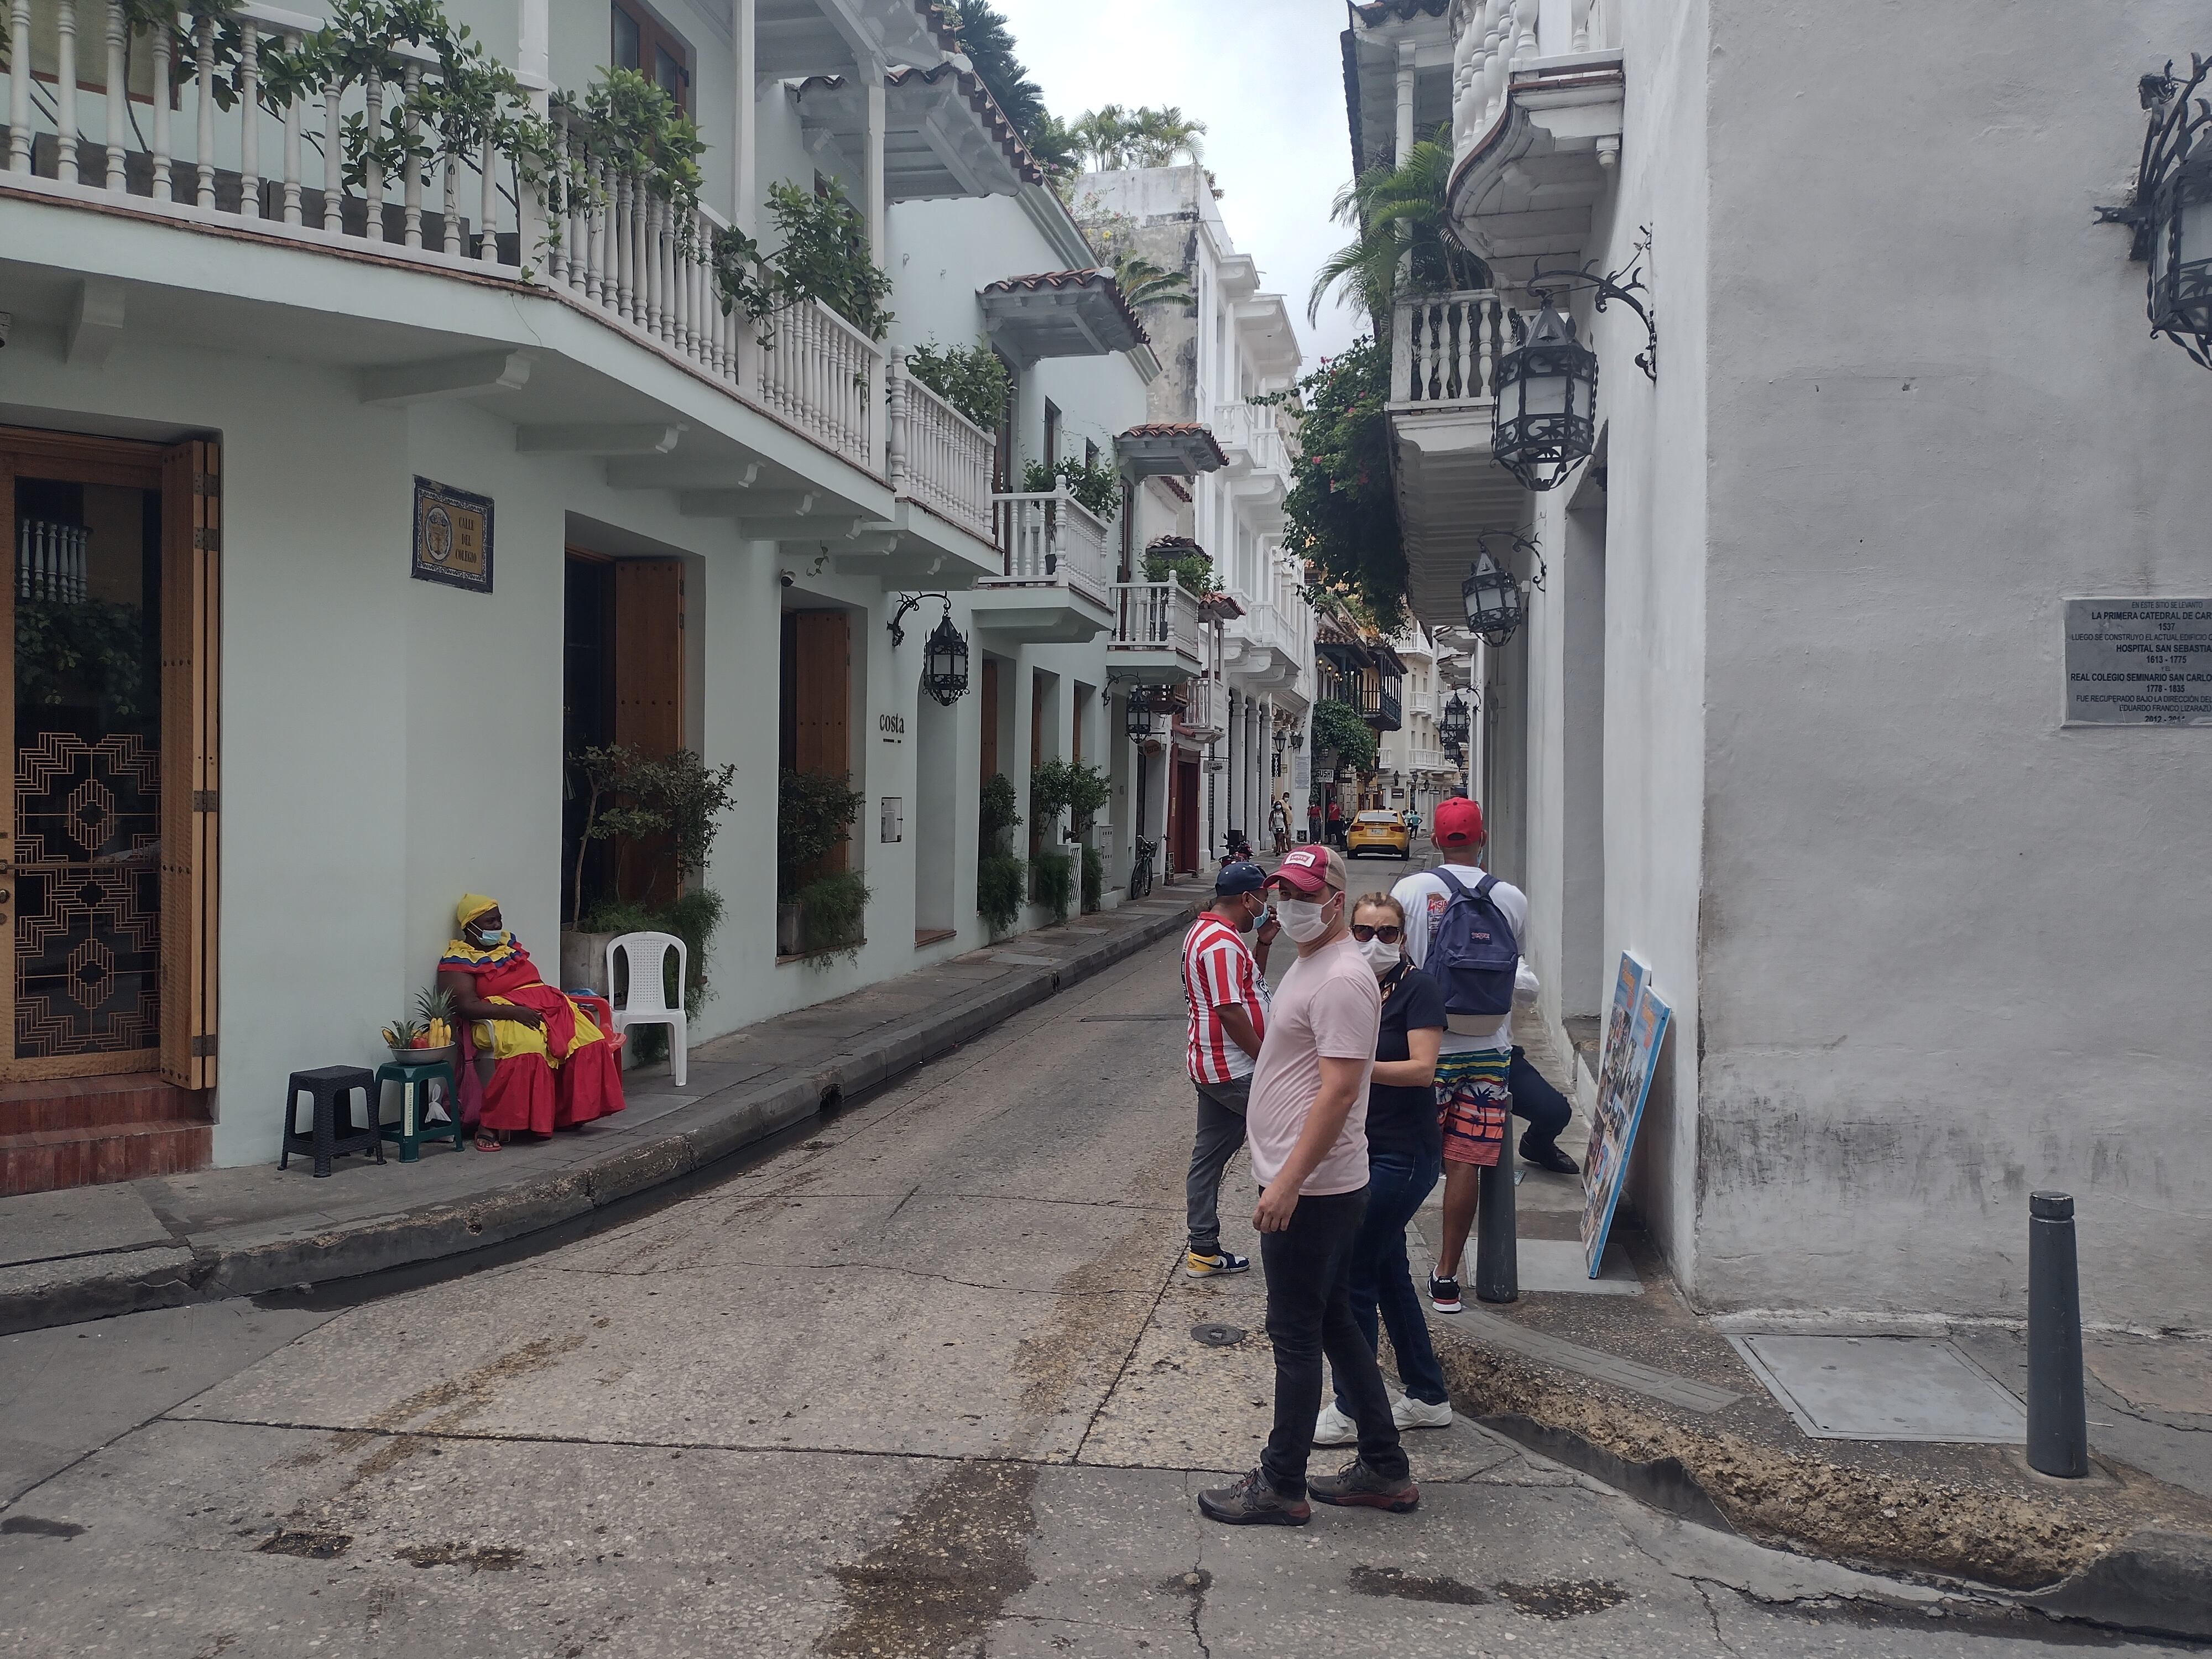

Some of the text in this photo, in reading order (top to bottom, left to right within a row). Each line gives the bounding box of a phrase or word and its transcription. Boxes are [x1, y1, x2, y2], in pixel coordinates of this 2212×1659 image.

[459, 517, 474, 531] CALLE
[461, 534, 472, 546] DEL
[455, 549, 477, 563] COLEGIO
[2104, 612, 2138, 620] PRIMERA
[2116, 644, 2153, 653] HOSPITAL
[2156, 644, 2172, 653] SAN
[2146, 655, 2163, 664] 1613
[2170, 655, 2187, 664] 1775
[2070, 673, 2090, 681] REAL
[2091, 673, 2125, 681] COLEGIO
[2126, 673, 2167, 681] SEMINARIO
[879, 713, 905, 734] costa
